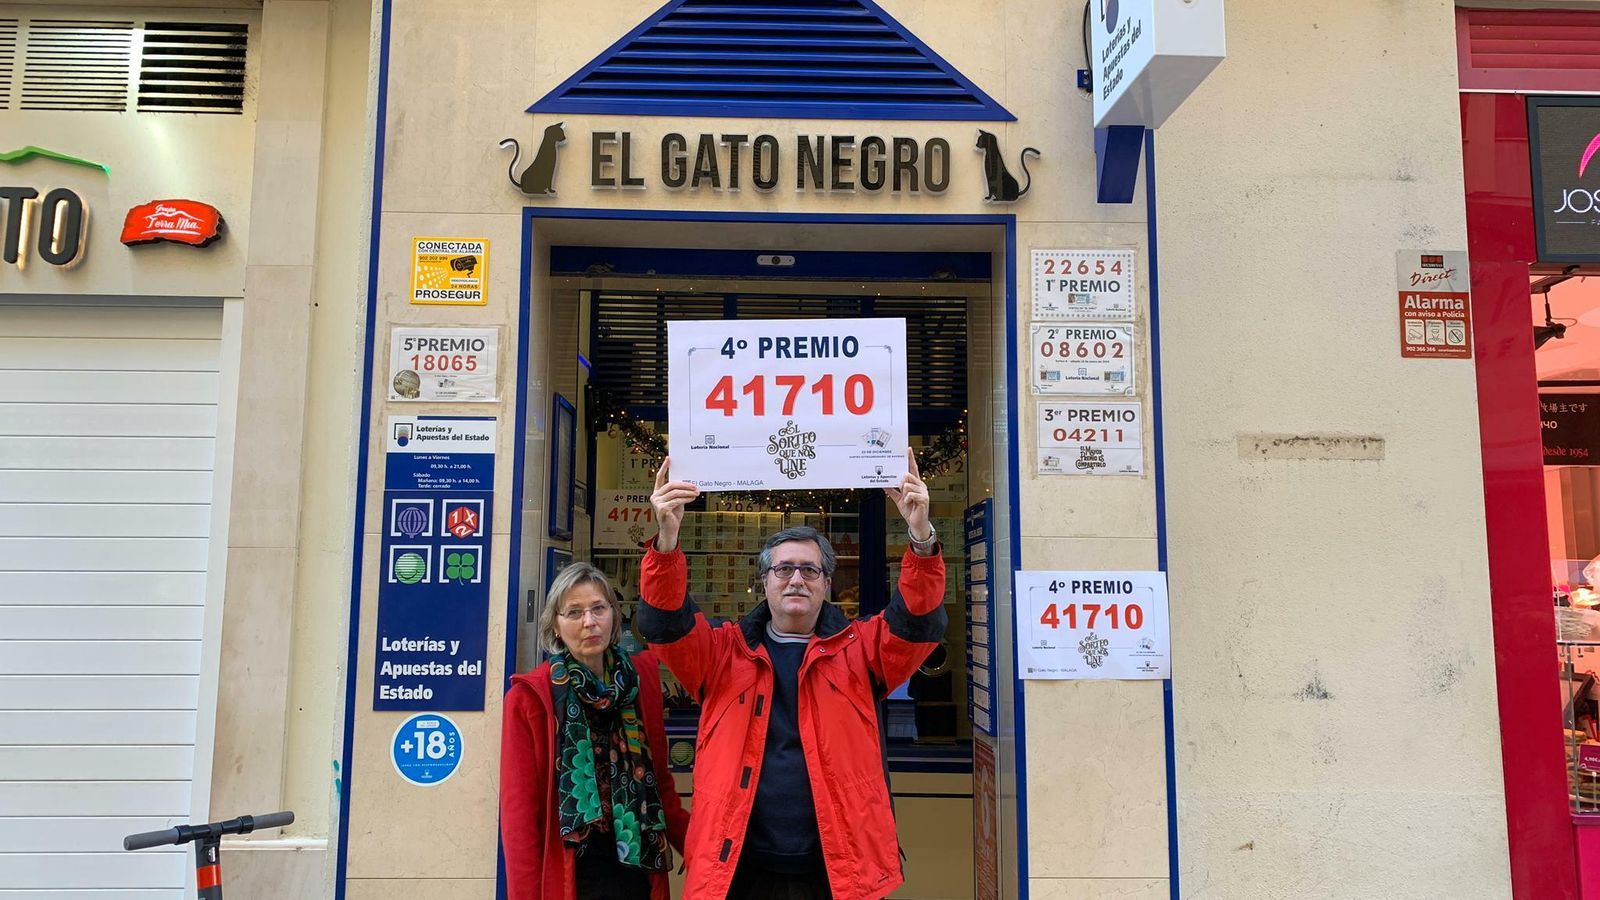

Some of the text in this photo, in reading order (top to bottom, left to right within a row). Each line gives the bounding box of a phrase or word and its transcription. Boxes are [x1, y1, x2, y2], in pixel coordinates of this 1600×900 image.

[1102, 17, 1131, 63] Loterías y
[1103, 20, 1142, 82] Apuestas del
[1103, 68, 1123, 100] Estado
[592, 132, 950, 193] EL GATO NEGRO
[0, 187, 84, 265] TO
[145, 216, 174, 229] Terra
[418, 242, 482, 250] CONECTADA
[1044, 259, 1122, 275] 22654
[1410, 268, 1456, 286] Direct
[1060, 280, 1120, 292] PREMIO
[416, 290, 480, 299] PROSEGUR
[1404, 295, 1464, 309] Alarma
[1048, 329, 1116, 340] 2º PREMIO
[418, 338, 485, 351] PREMIO
[721, 336, 858, 359] 4º PREMIO
[1041, 342, 1123, 358] 08602
[411, 354, 477, 371] 18065
[706, 374, 874, 416] 41710
[1045, 409, 1135, 422] 3er PREMIO
[1053, 428, 1123, 442] 04211
[767, 432, 816, 455] SORTEO
[779, 445, 816, 459] QUE NOS
[1569, 448, 1589, 457] 1954
[774, 458, 807, 479] UNE
[1049, 580, 1132, 594] 4º PREMIO
[1040, 604, 1143, 629] 41710
[382, 637, 460, 655] Loterías y
[1078, 639, 1108, 653] SORTEO
[380, 660, 481, 679] Apuestas del
[380, 684, 433, 699] Estado
[401, 731, 447, 759] +18
